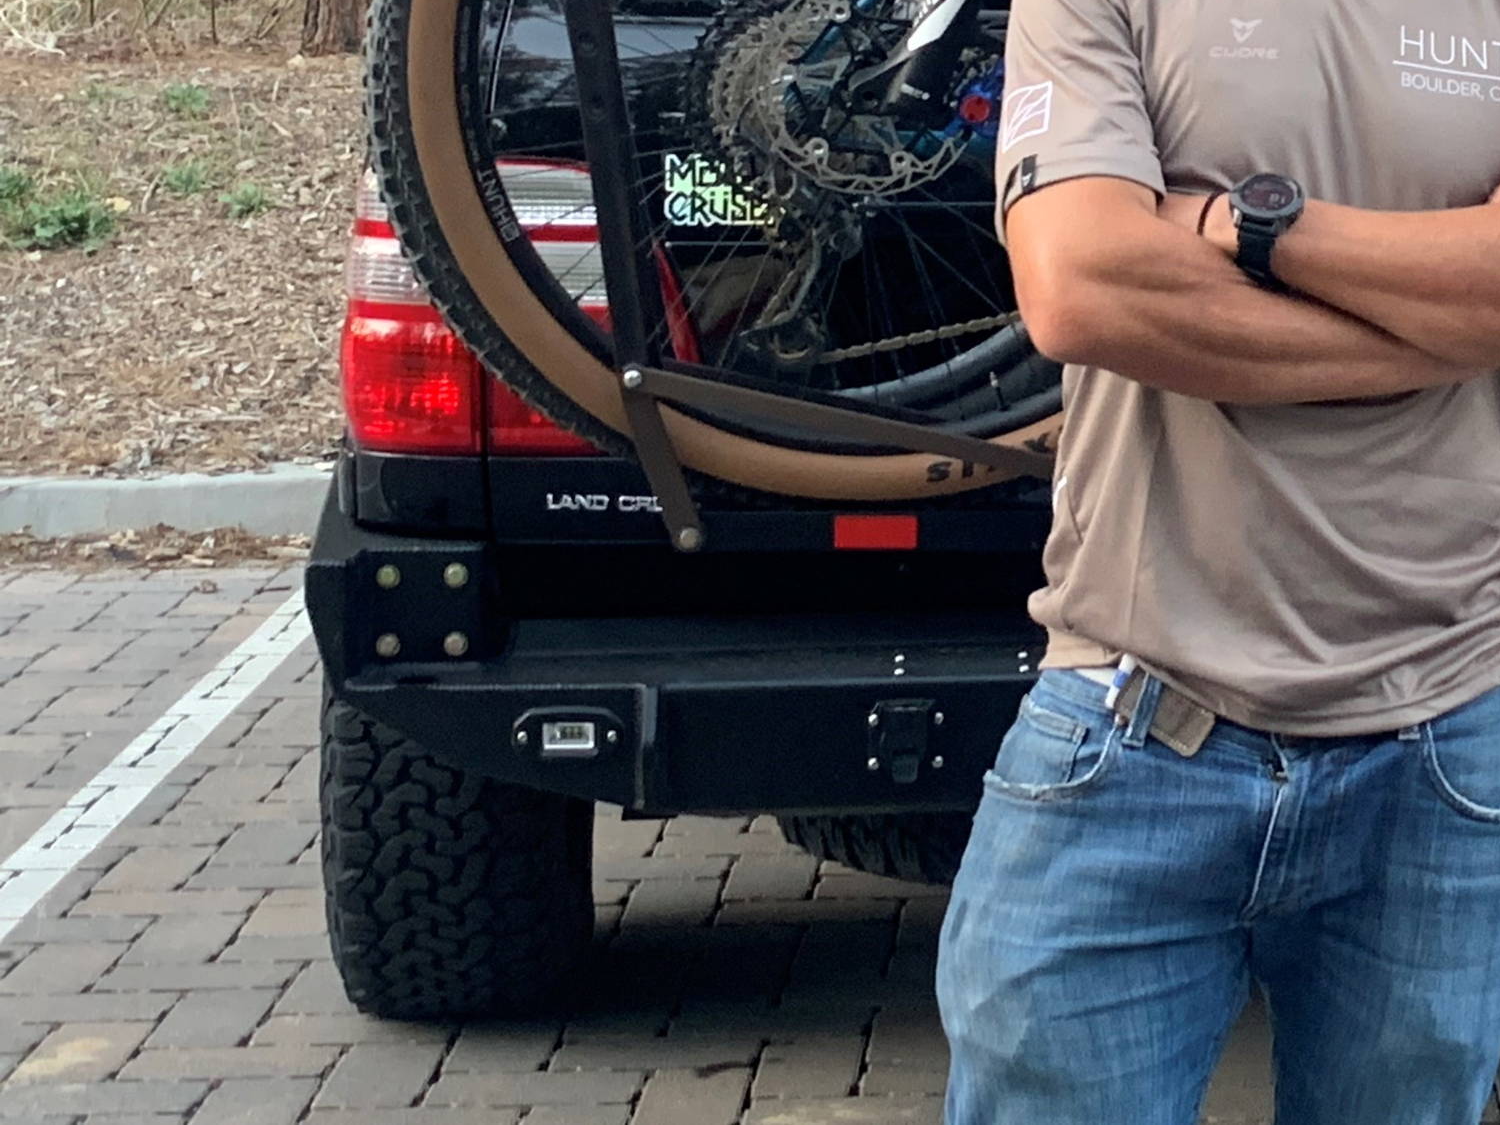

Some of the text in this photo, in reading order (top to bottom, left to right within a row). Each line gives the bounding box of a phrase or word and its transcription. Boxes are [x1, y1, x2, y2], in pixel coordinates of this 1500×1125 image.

[1401, 71, 1485, 101] BOULDER,
[476, 168, 512, 226] HUNT
[546, 493, 610, 510] LAND
